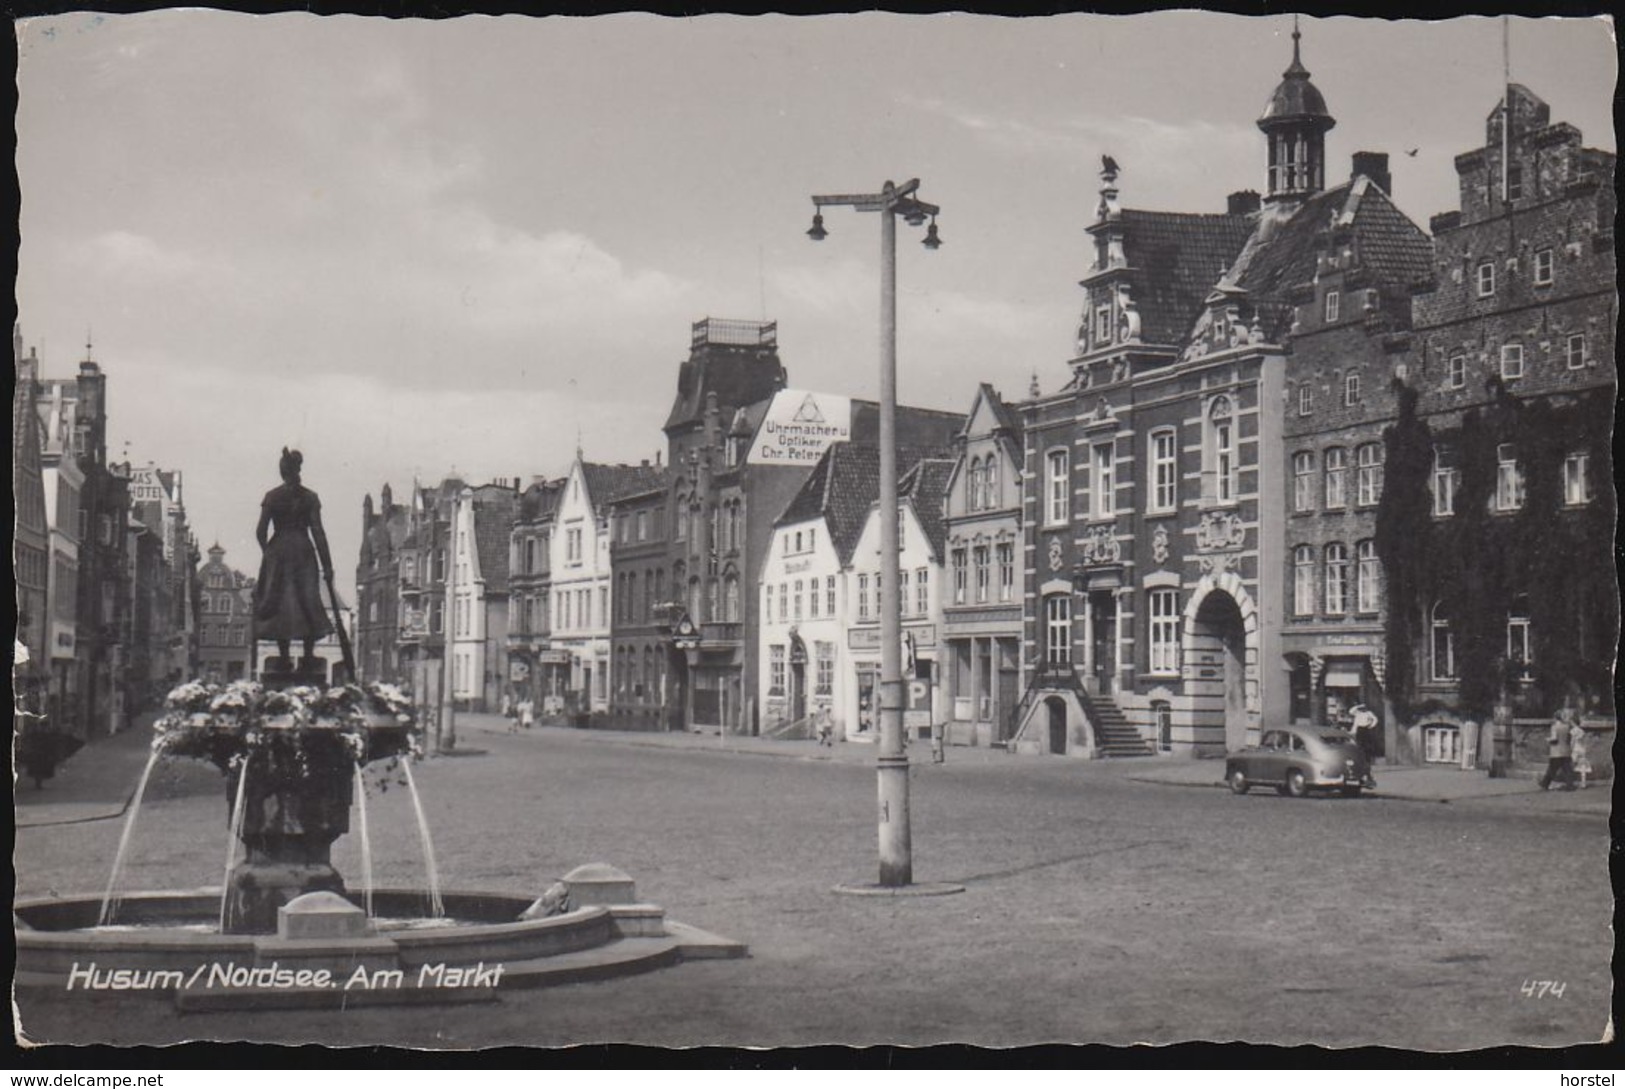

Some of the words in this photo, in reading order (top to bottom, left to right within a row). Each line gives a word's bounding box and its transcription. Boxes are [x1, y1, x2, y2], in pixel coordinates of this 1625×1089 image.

[766, 420, 838, 437] Uhrmacher
[779, 434, 822, 447] Optiker
[788, 447, 825, 461] Peter
[908, 682, 927, 709] P
